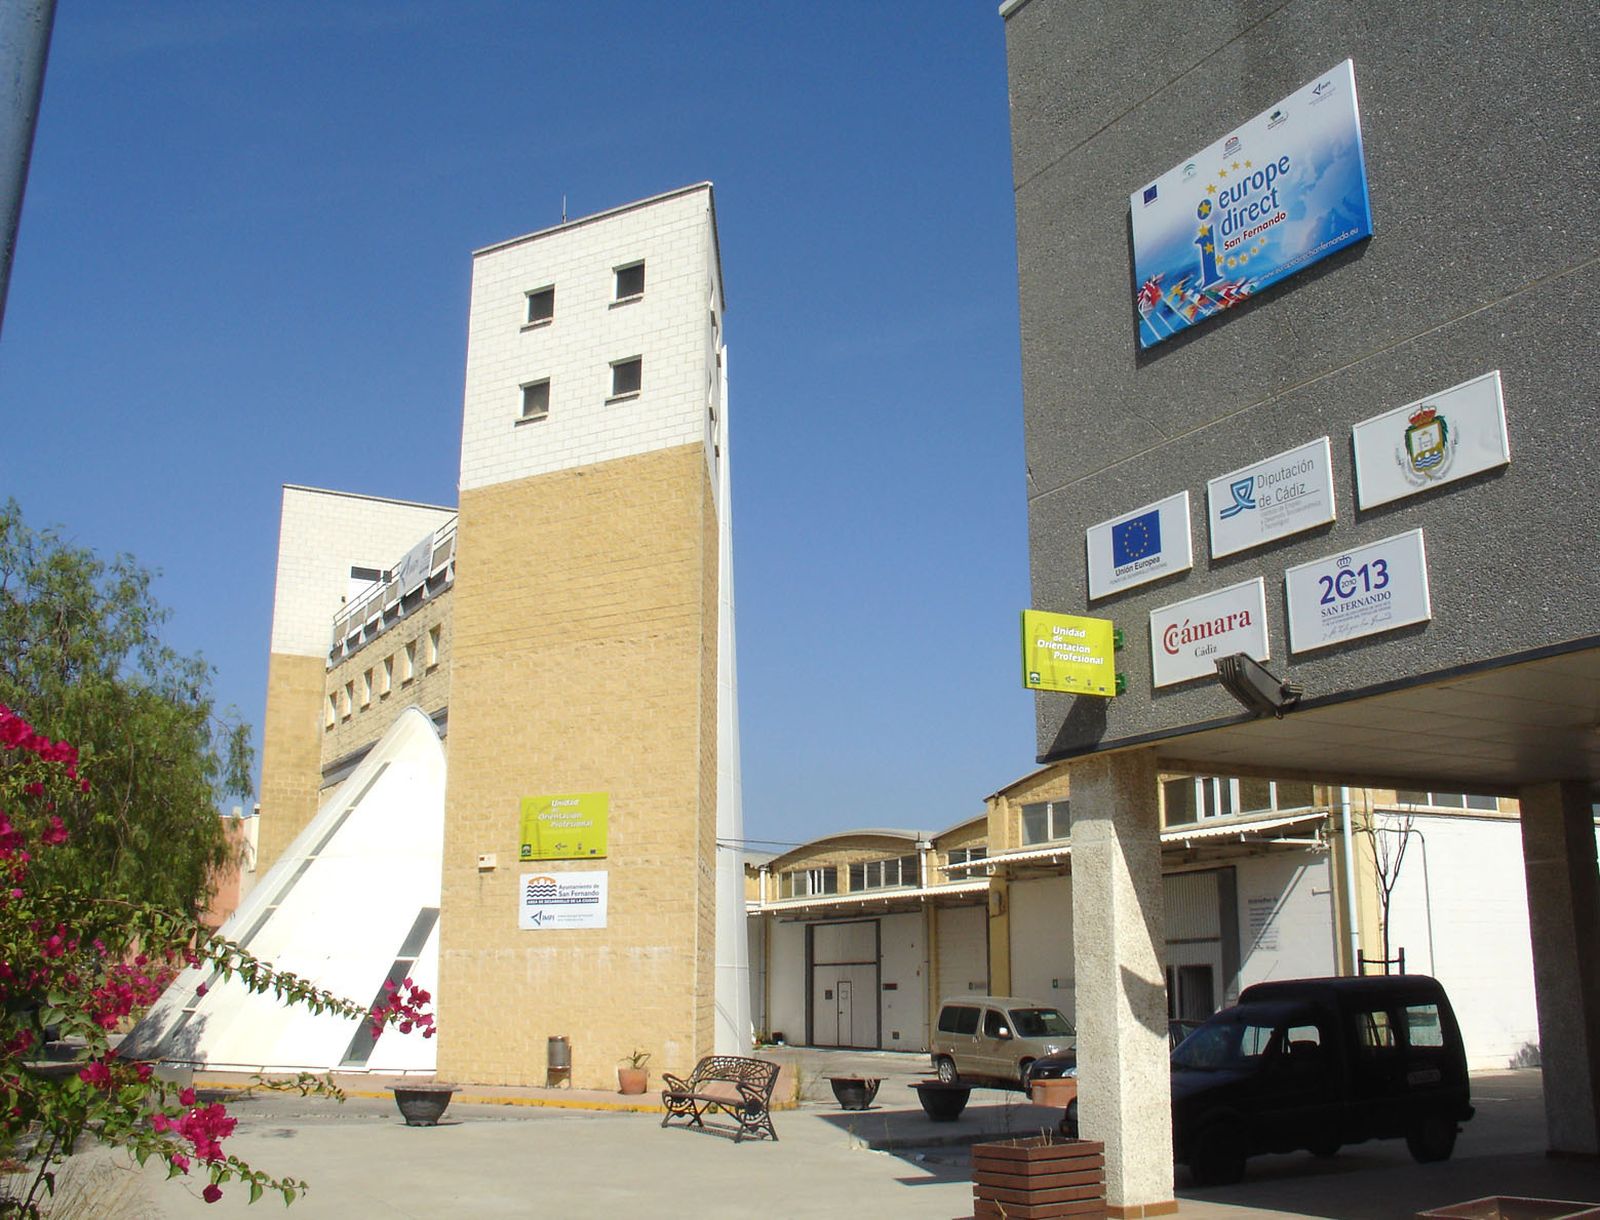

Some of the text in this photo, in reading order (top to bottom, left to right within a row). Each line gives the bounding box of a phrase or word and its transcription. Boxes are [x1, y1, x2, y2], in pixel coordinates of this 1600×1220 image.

[1218, 155, 1290, 209] europe
[1221, 187, 1280, 237] direct
[1224, 211, 1287, 251] San Fernando
[1257, 459, 1314, 489] Diputación
[1259, 482, 1306, 508] de Cádiz
[1115, 564, 1134, 577] Unión
[1134, 556, 1161, 570] Europea
[1318, 558, 1390, 605] 2013
[1321, 604, 1339, 617] SAN
[1340, 590, 1392, 613] FERNANDO
[1053, 626, 1086, 638] Unidad
[1163, 610, 1252, 655] Cámara
[1053, 651, 1104, 665] Profesional
[1194, 644, 1218, 658] Cádiz
[551, 799, 579, 807] Unidad
[551, 820, 593, 828] Profesional
